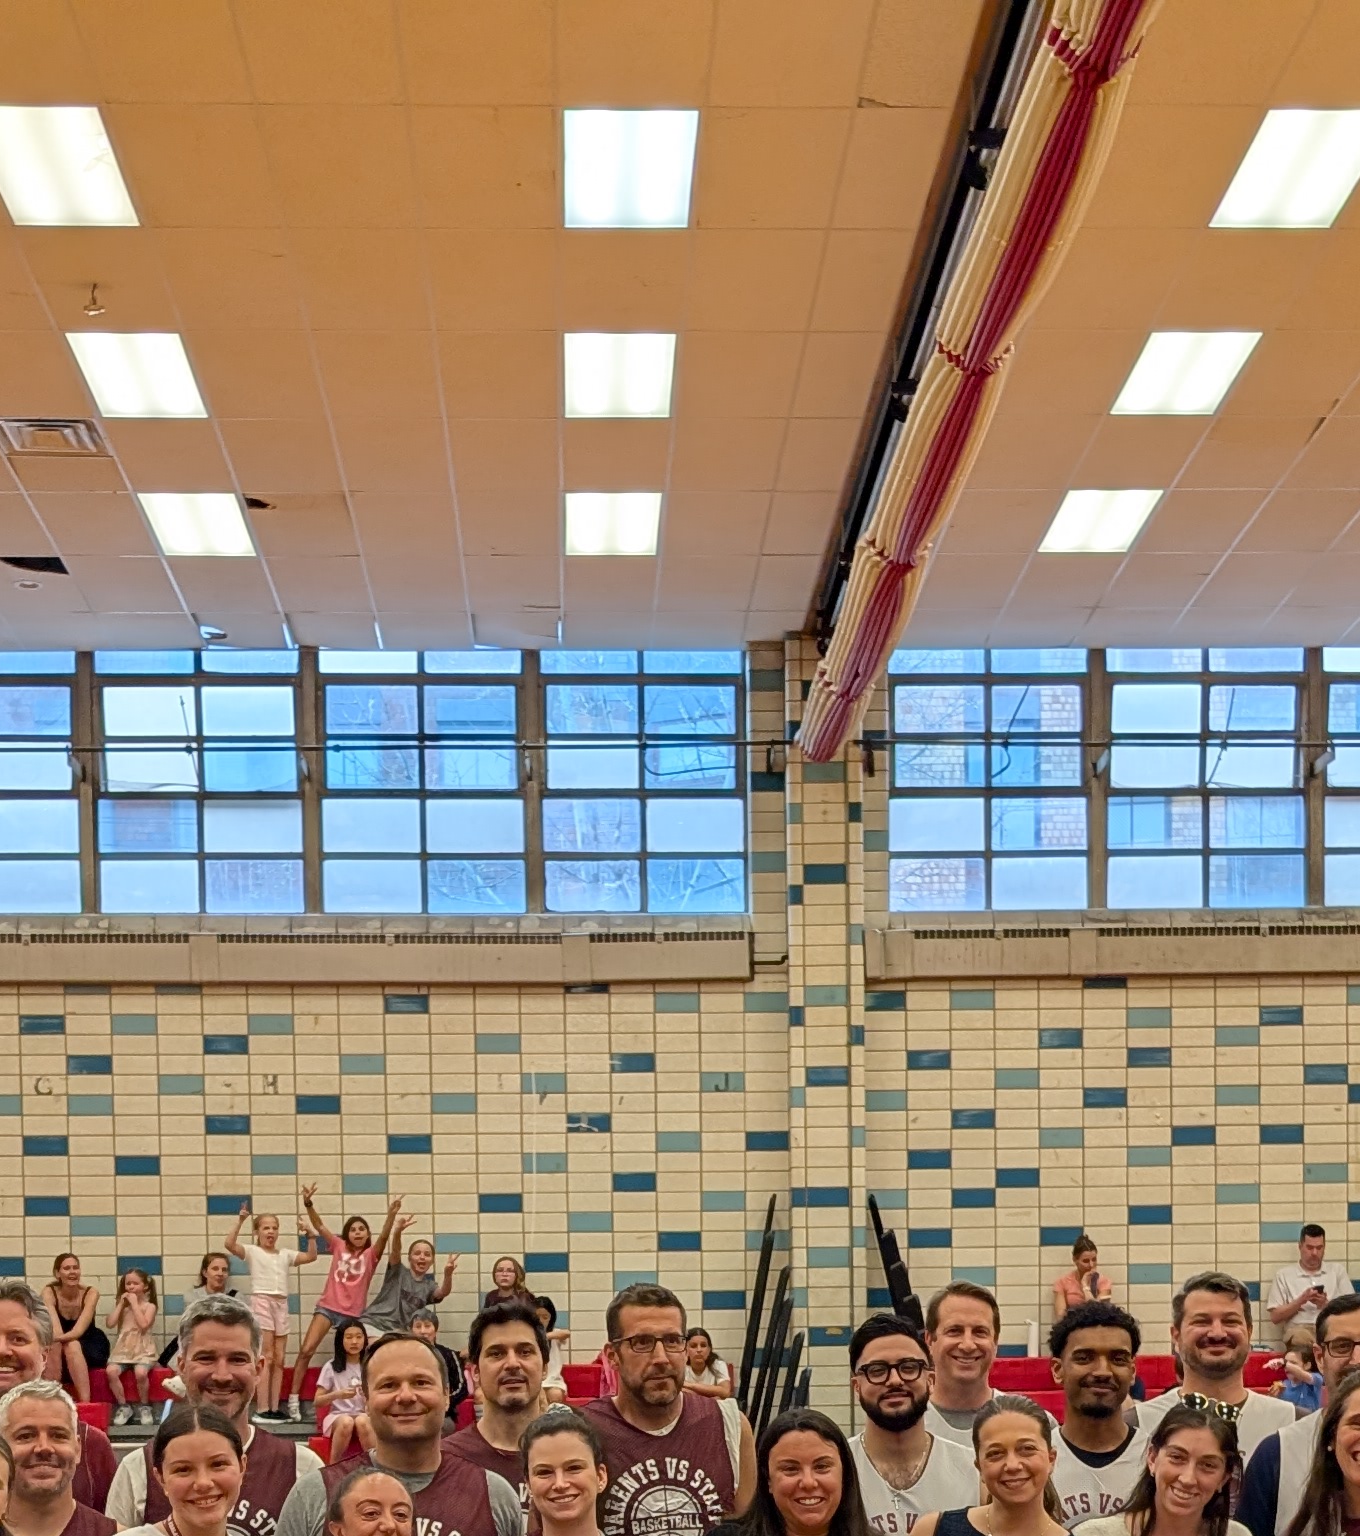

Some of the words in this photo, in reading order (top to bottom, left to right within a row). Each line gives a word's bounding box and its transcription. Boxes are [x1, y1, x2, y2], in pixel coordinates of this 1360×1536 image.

[714, 1073, 730, 1092] J
[604, 1459, 660, 1536] PARENTS
[665, 1457, 690, 1481] VS
[1097, 1493, 1124, 1515] VS
[631, 1514, 704, 1535] BASKETBALL
